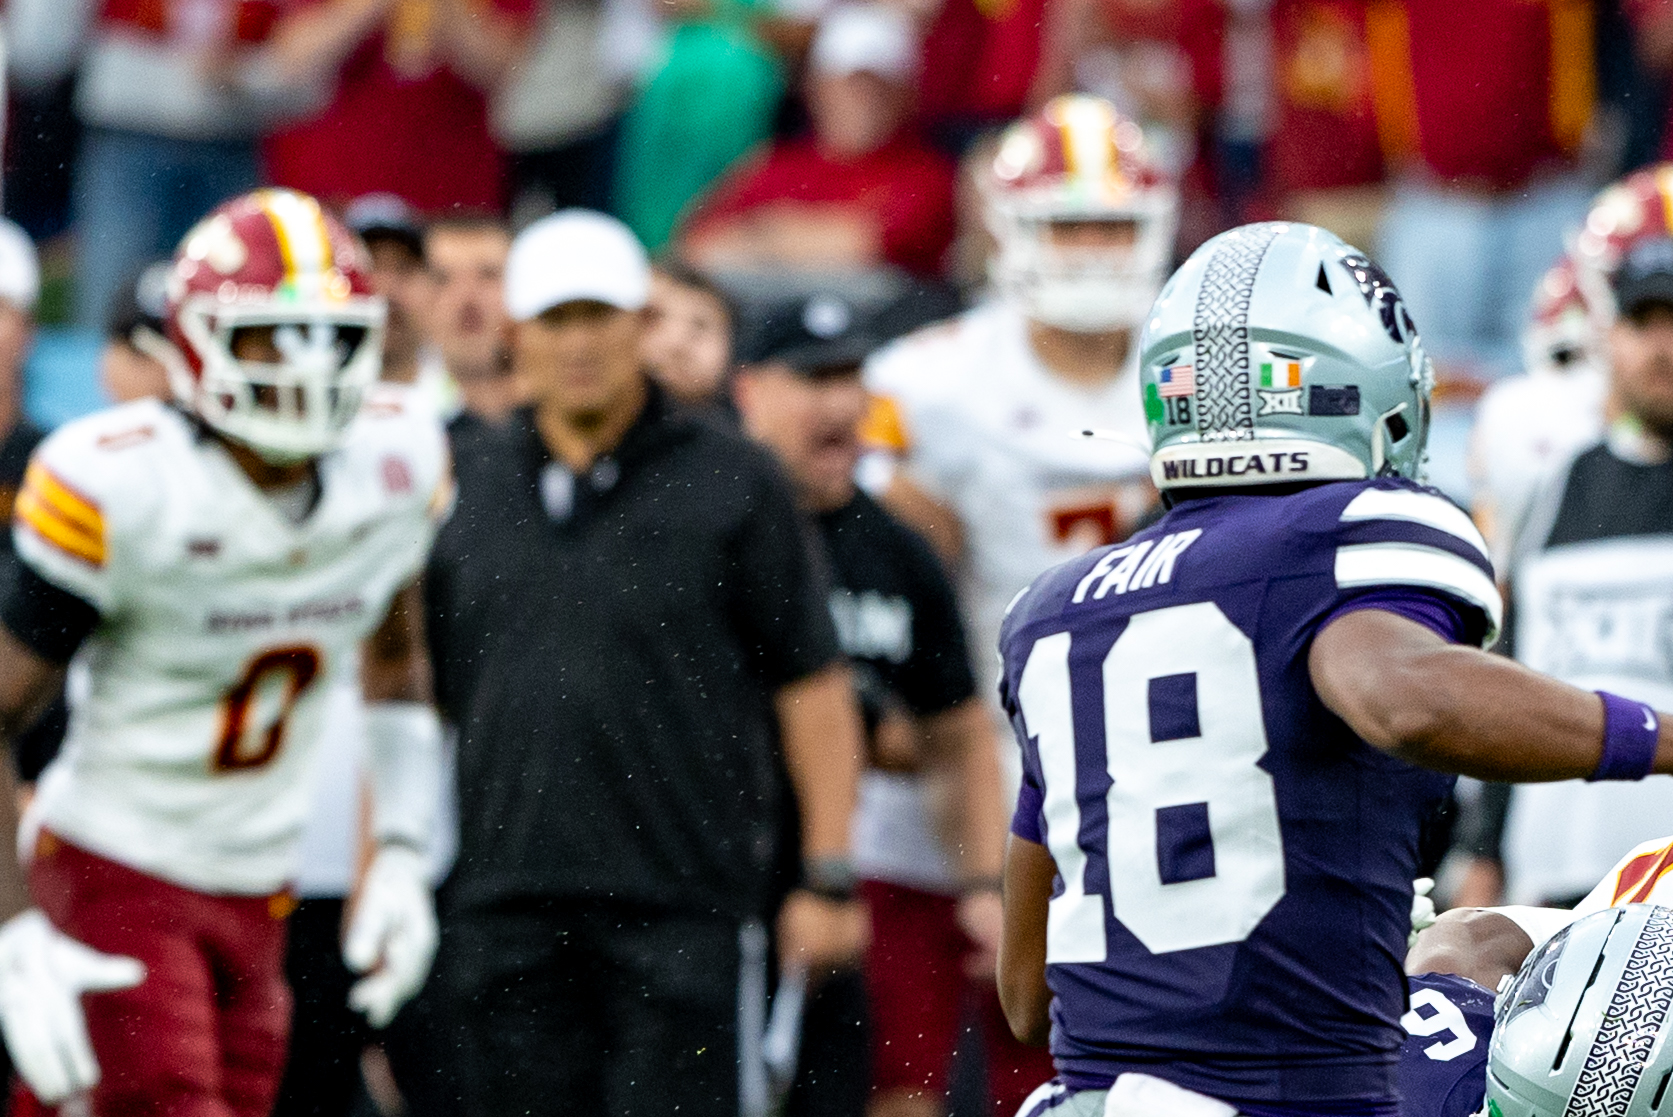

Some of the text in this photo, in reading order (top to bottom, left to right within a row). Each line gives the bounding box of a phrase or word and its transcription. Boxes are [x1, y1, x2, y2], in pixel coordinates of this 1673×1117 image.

[1167, 397, 1191, 425] 18
[1163, 452, 1309, 480] WILDCATS
[1072, 528, 1203, 604] FAIR
[208, 645, 322, 777] 0
[1017, 601, 1286, 964] 18
